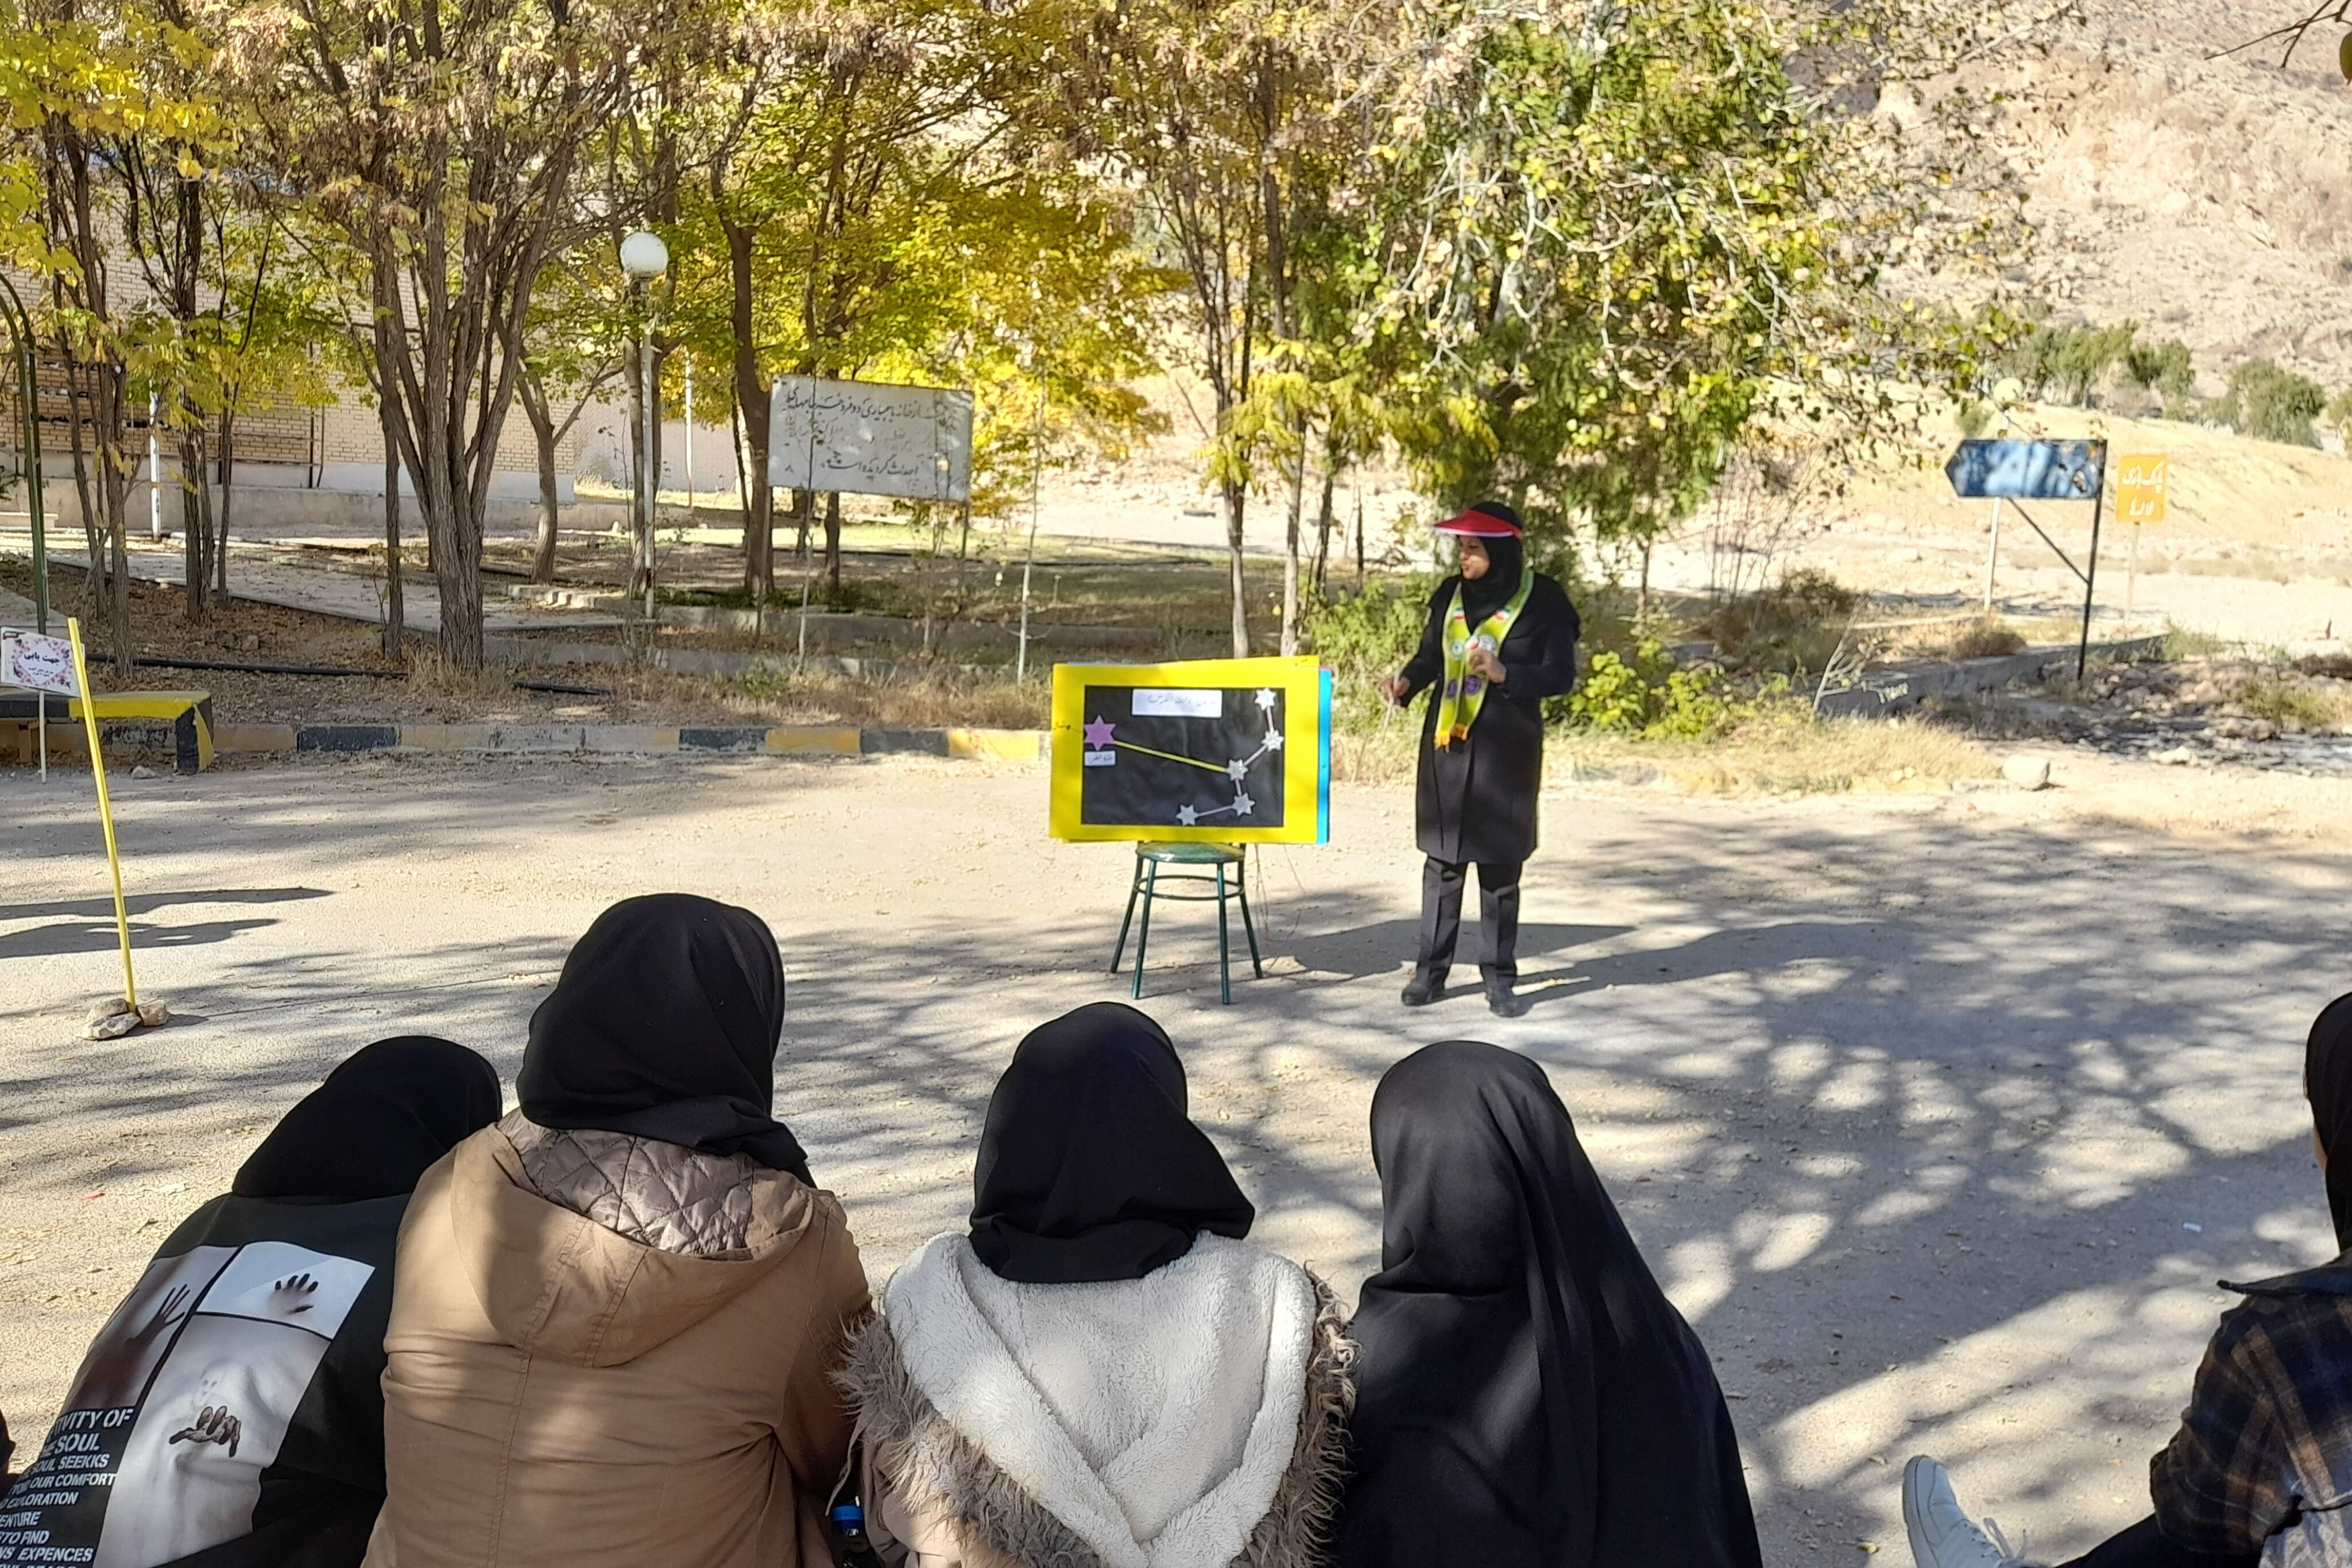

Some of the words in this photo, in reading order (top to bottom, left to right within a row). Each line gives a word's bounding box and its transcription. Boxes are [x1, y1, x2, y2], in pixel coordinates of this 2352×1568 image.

[42, 655, 60, 667] جهت
[103, 1408, 134, 1428] OF
[54, 1433, 100, 1454] SOUL
[57, 1453, 110, 1470] SEEKKS
[29, 1475, 56, 1489] OUR
[55, 1473, 118, 1487] COMFORT
[20, 1530, 50, 1545] FIND
[17, 1547, 94, 1562] EXPENCES
